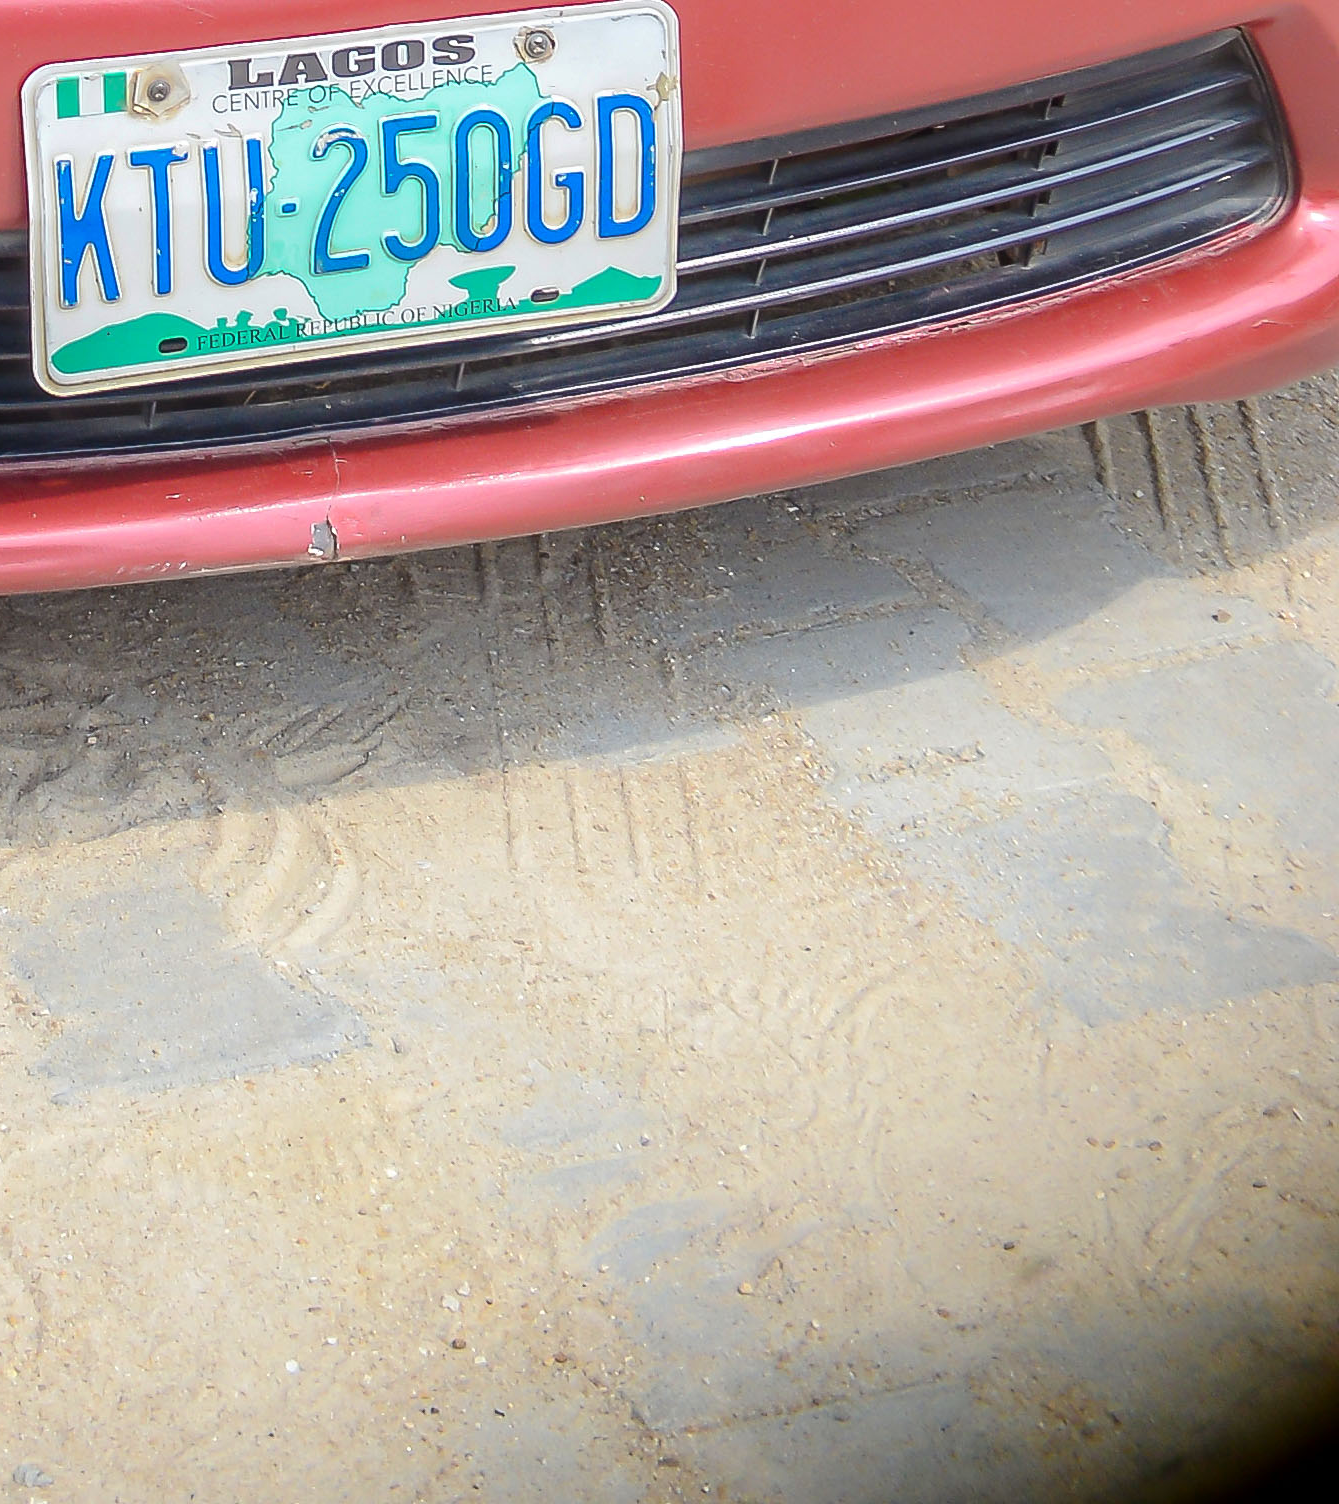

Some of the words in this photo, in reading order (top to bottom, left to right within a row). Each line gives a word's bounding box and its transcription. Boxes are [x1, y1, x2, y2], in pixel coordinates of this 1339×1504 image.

[212, 88, 299, 114] CENTRE
[308, 84, 339, 104] OF
[349, 64, 494, 99] EXCELLENCE
[227, 35, 476, 91] LAGOS
[55, 93, 657, 308] KTU-250GD
[196, 324, 290, 351] FEDERAL
[295, 310, 395, 337] REPUBLIC
[400, 306, 427, 324] OF
[433, 297, 518, 320] NIGERIA
